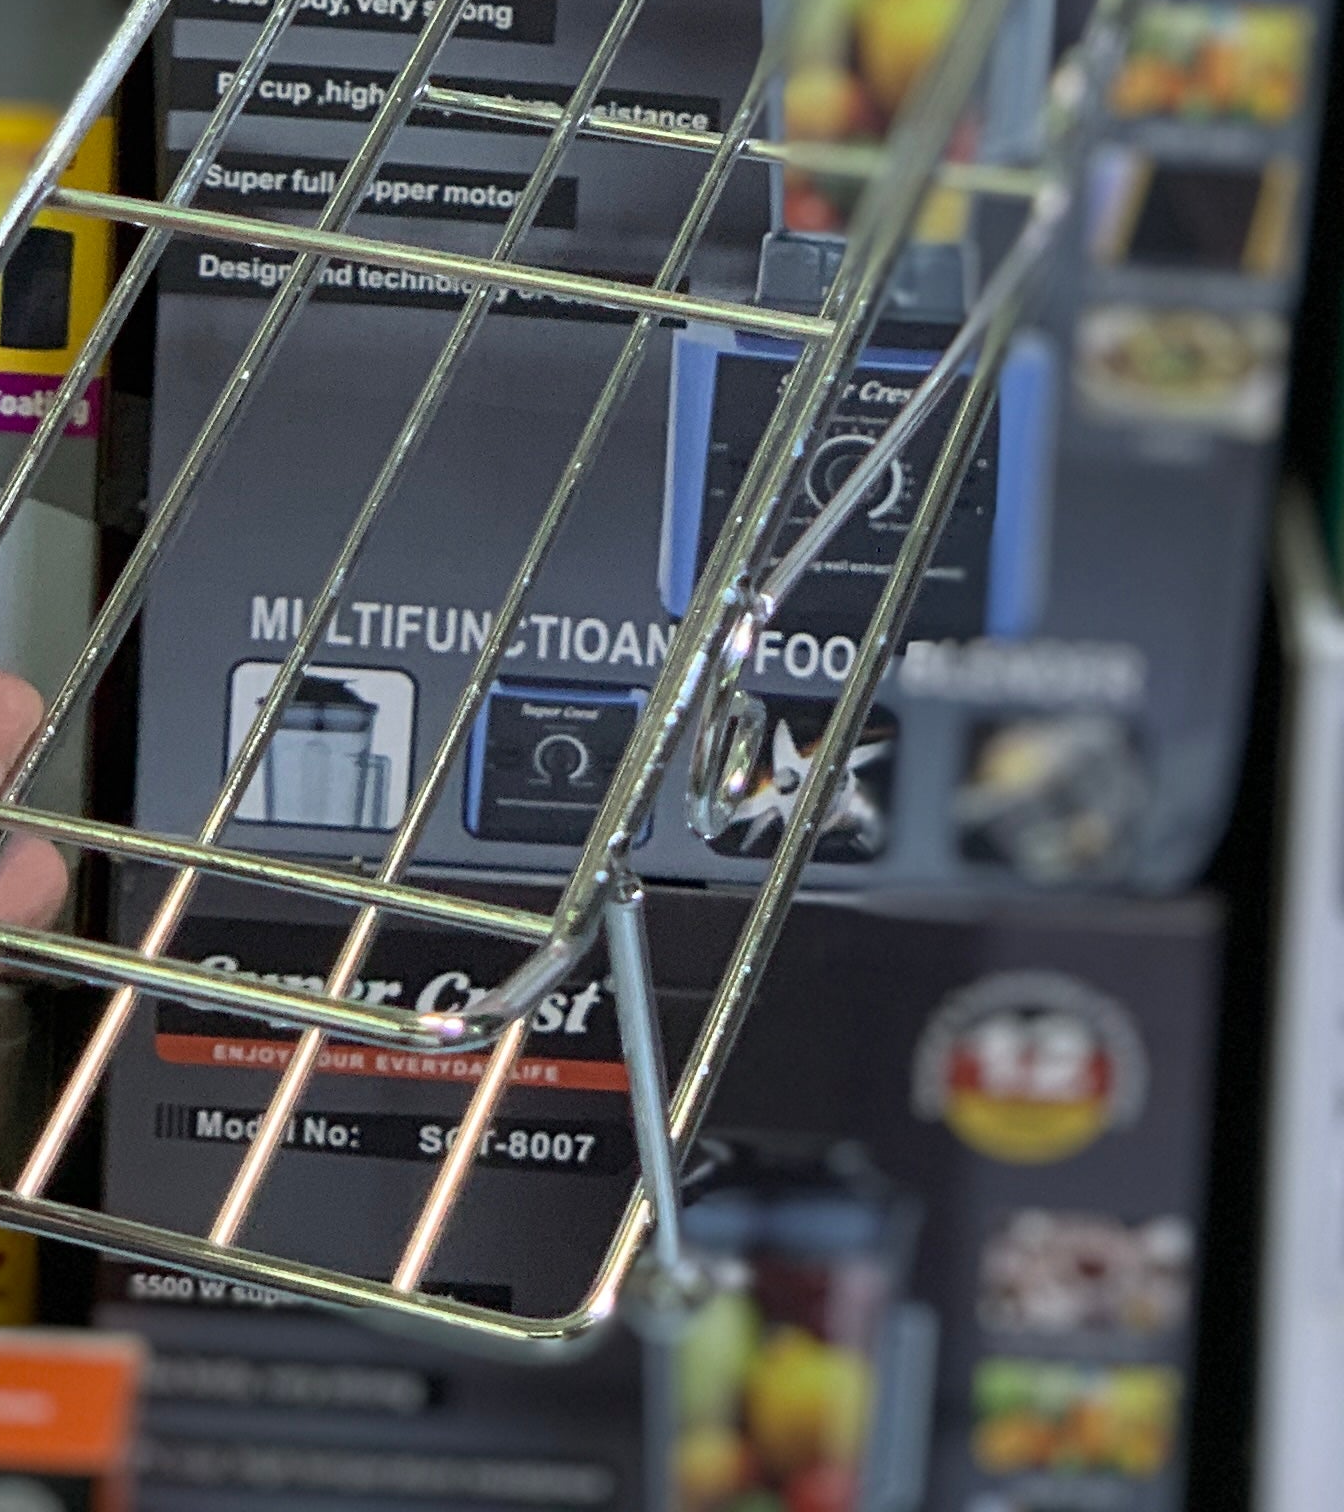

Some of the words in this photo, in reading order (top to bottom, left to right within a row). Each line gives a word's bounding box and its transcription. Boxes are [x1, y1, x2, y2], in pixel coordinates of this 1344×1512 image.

[258, 79, 312, 105] cup
[591, 99, 710, 131] sistance
[205, 163, 287, 194] Super
[291, 168, 336, 194] full
[364, 179, 440, 204] opper
[198, 253, 293, 287] Design
[318, 262, 354, 287] nd
[357, 263, 508, 304] technooy
[859, 379, 916, 404] Cres
[754, 630, 871, 683] FOO
[414, 971, 604, 1035] Cst
[316, 1049, 365, 1070] OUR
[375, 1057, 488, 1080] EVERYDA
[196, 1110, 295, 1143] Mol
[304, 1117, 361, 1147] No:
